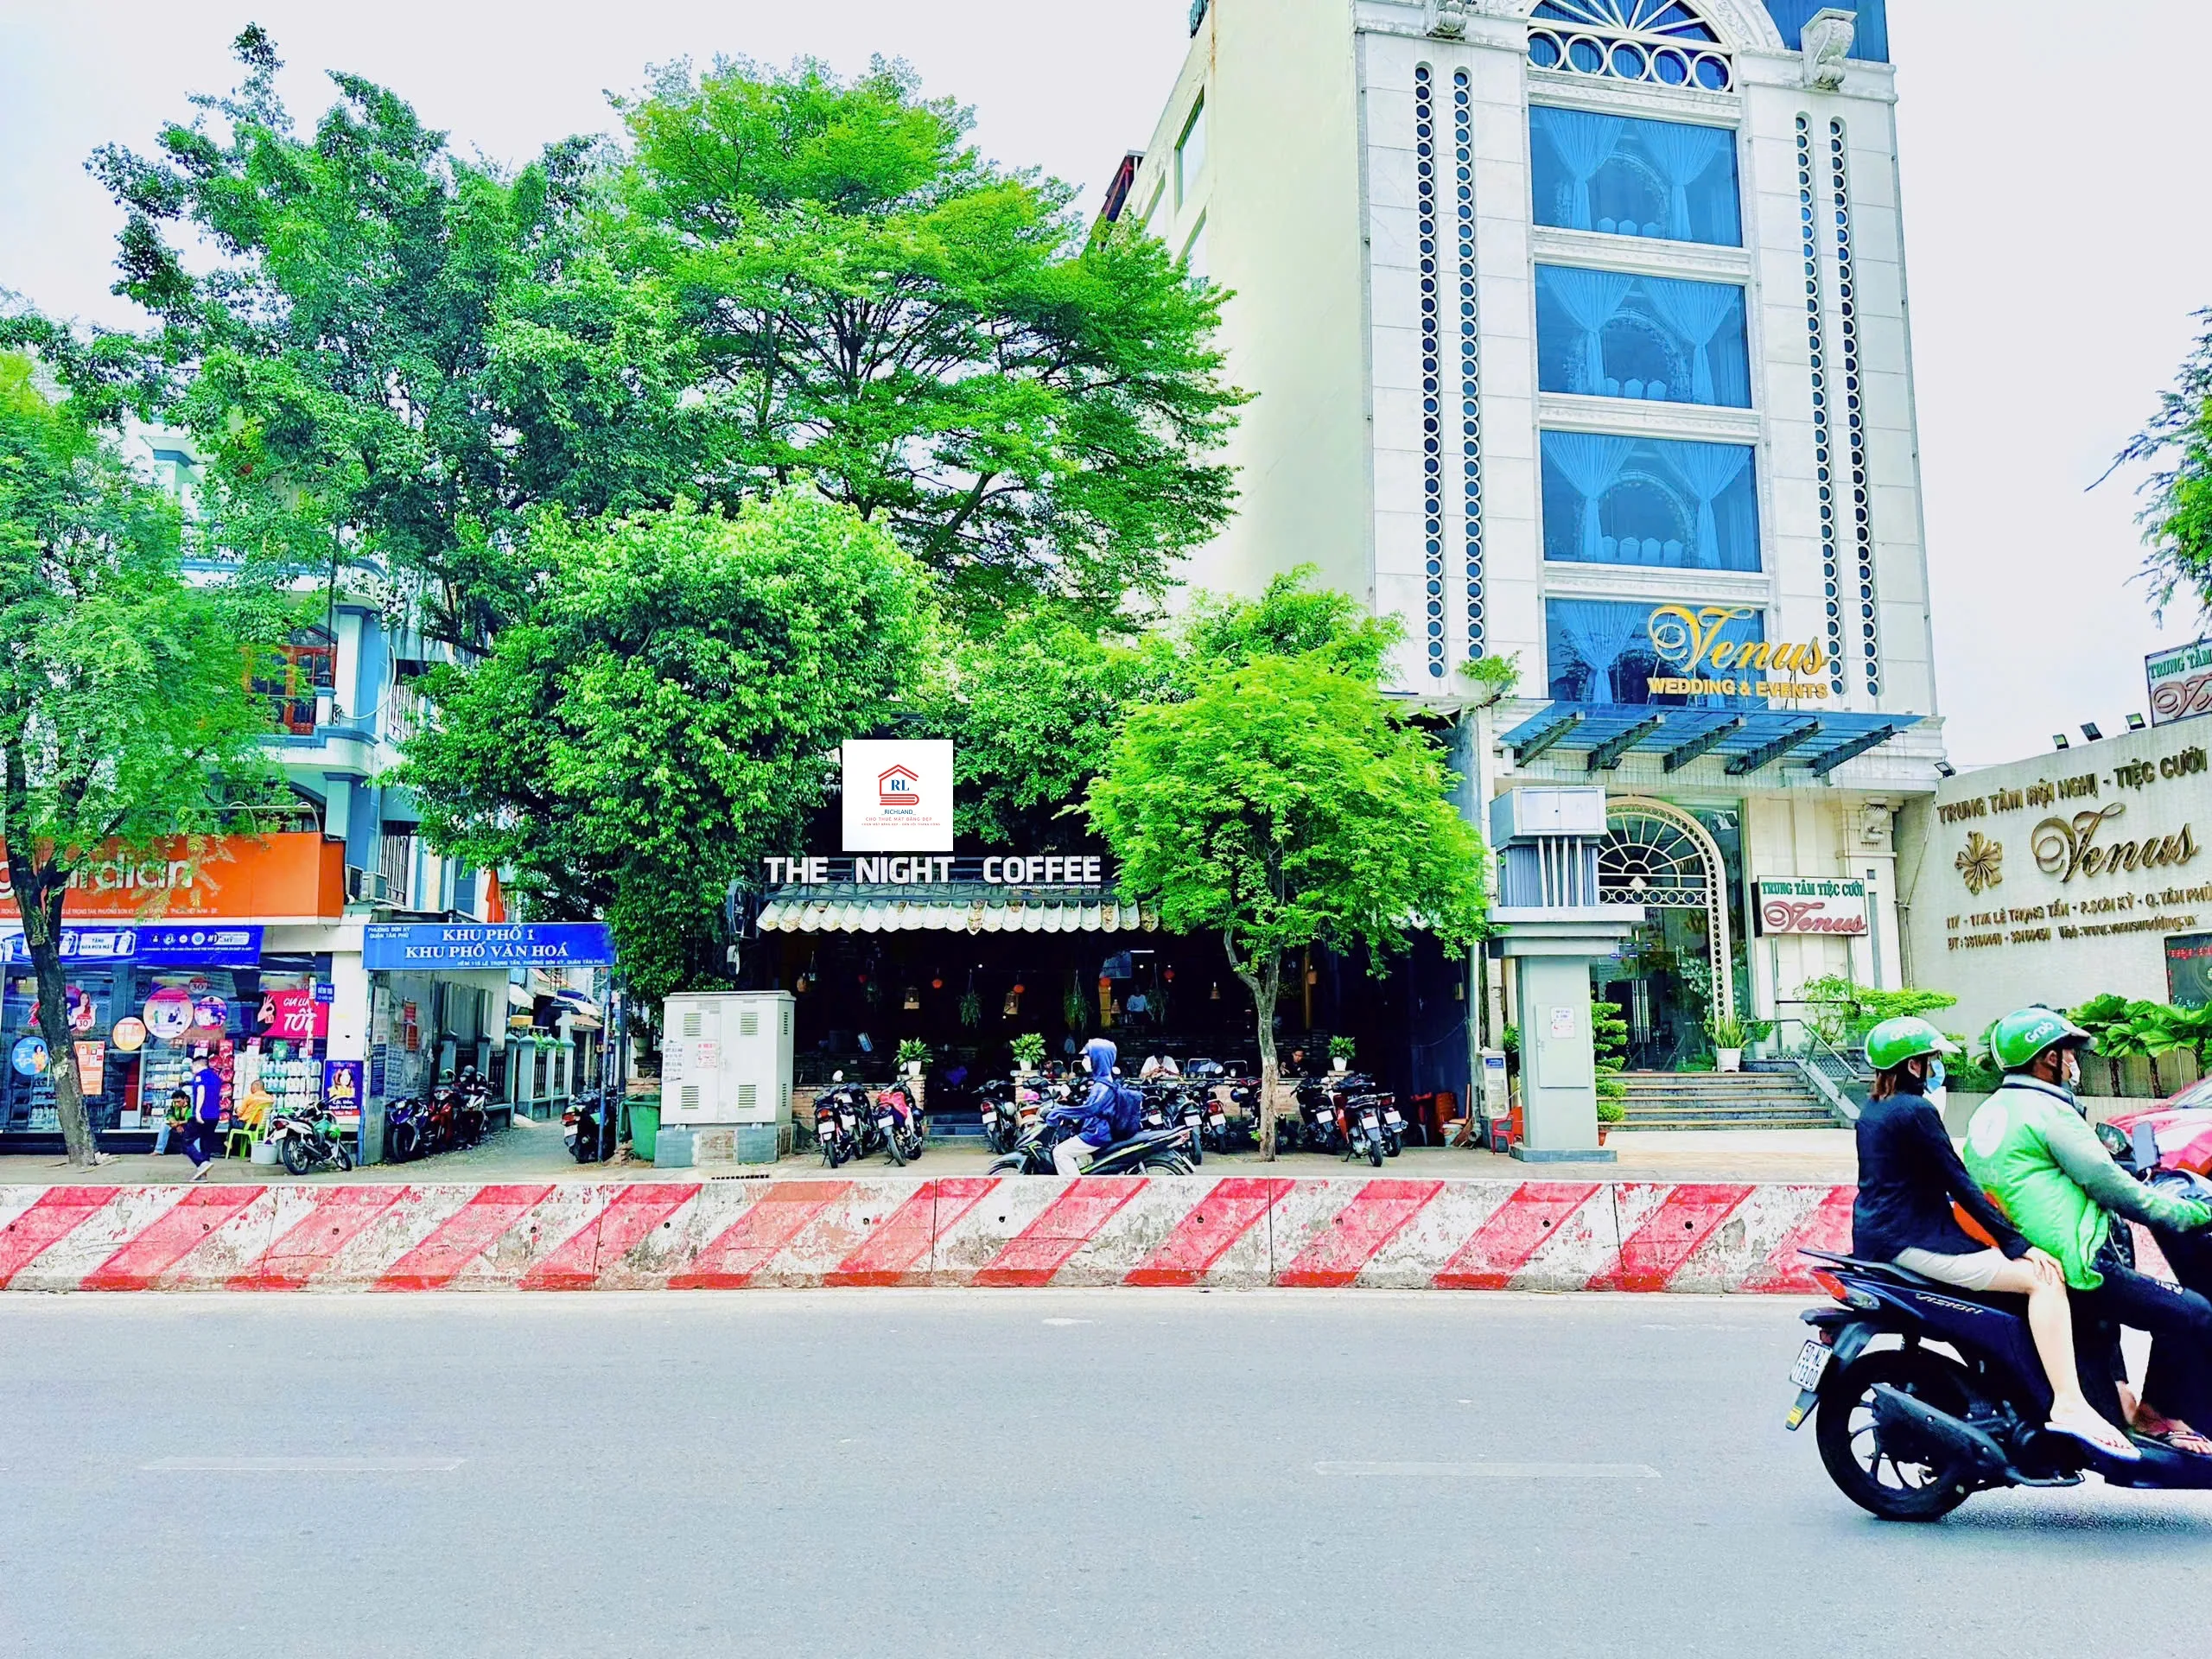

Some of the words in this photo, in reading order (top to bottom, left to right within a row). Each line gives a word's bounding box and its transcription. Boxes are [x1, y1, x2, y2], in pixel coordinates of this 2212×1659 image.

[1648, 605, 1830, 676] Venus
[2149, 656, 2185, 679] TRUNG
[1647, 677, 1736, 696] WEDDING
[1739, 680, 1752, 696] &
[1756, 681, 1828, 700] EVENTS
[1936, 796, 1987, 824] TRUNG
[1988, 787, 2024, 814] TÂM
[2026, 778, 2055, 809] HỘI
[2058, 772, 2098, 798] NGHỊ
[2113, 757, 2155, 791] TIỆC
[2160, 745, 2208, 778] CƯỚI
[2031, 802, 2202, 883] Venus
[764, 857, 829, 884] THE
[855, 856, 955, 884] NIGHT
[983, 855, 1102, 883] COFFEE
[1761, 881, 1793, 895] TRUNG
[1795, 880, 1815, 896] TÂM
[1818, 880, 1840, 898] TIỆC
[1842, 880, 1864, 897] CƯỚI
[1763, 900, 1867, 932] Venus
[442, 929, 481, 942] KHU
[486, 924, 524, 941] PHỐ
[526, 929, 535, 940] 1
[405, 946, 446, 958] KHU
[448, 941, 486, 958] PHỐ
[490, 943, 528, 957] VĂN
[531, 942, 569, 957] HOÁ
[1890, 1026, 1923, 1041] Grab
[2024, 1020, 2056, 1043] Grab
[1916, 1293, 1984, 1314] VISION
